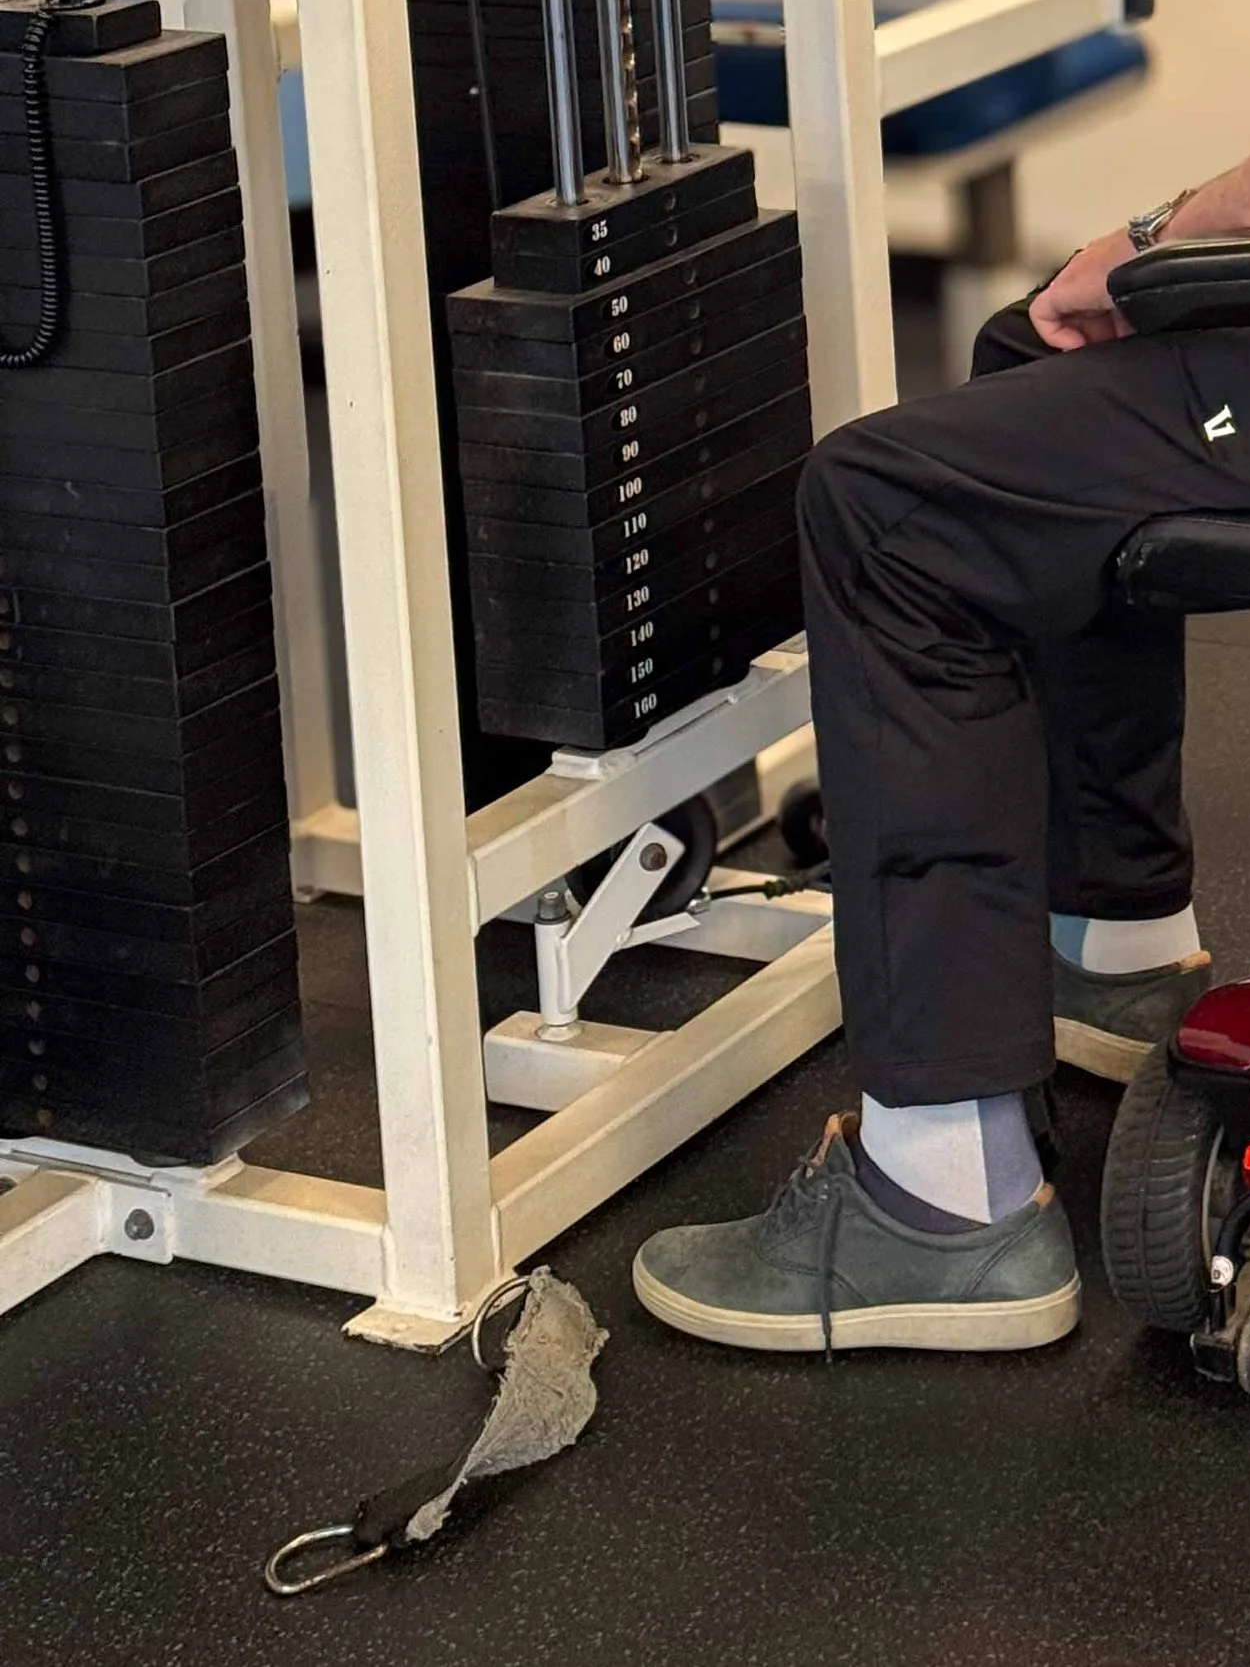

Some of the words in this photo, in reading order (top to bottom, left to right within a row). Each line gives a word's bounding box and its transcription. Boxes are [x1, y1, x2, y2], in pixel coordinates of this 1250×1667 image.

[591, 219, 608, 241] 35
[594, 256, 611, 276] 40
[611, 295, 628, 317] 50
[613, 332, 630, 353] 60
[616, 369, 633, 389] 70
[620, 405, 637, 427] 80
[622, 440, 639, 462] 90
[619, 477, 642, 502] 100
[624, 512, 647, 538] 110
[626, 549, 649, 574] 120
[626, 586, 649, 611] 130
[630, 621, 654, 647] 140
[630, 658, 654, 683] 150
[634, 693, 657, 719] 160
